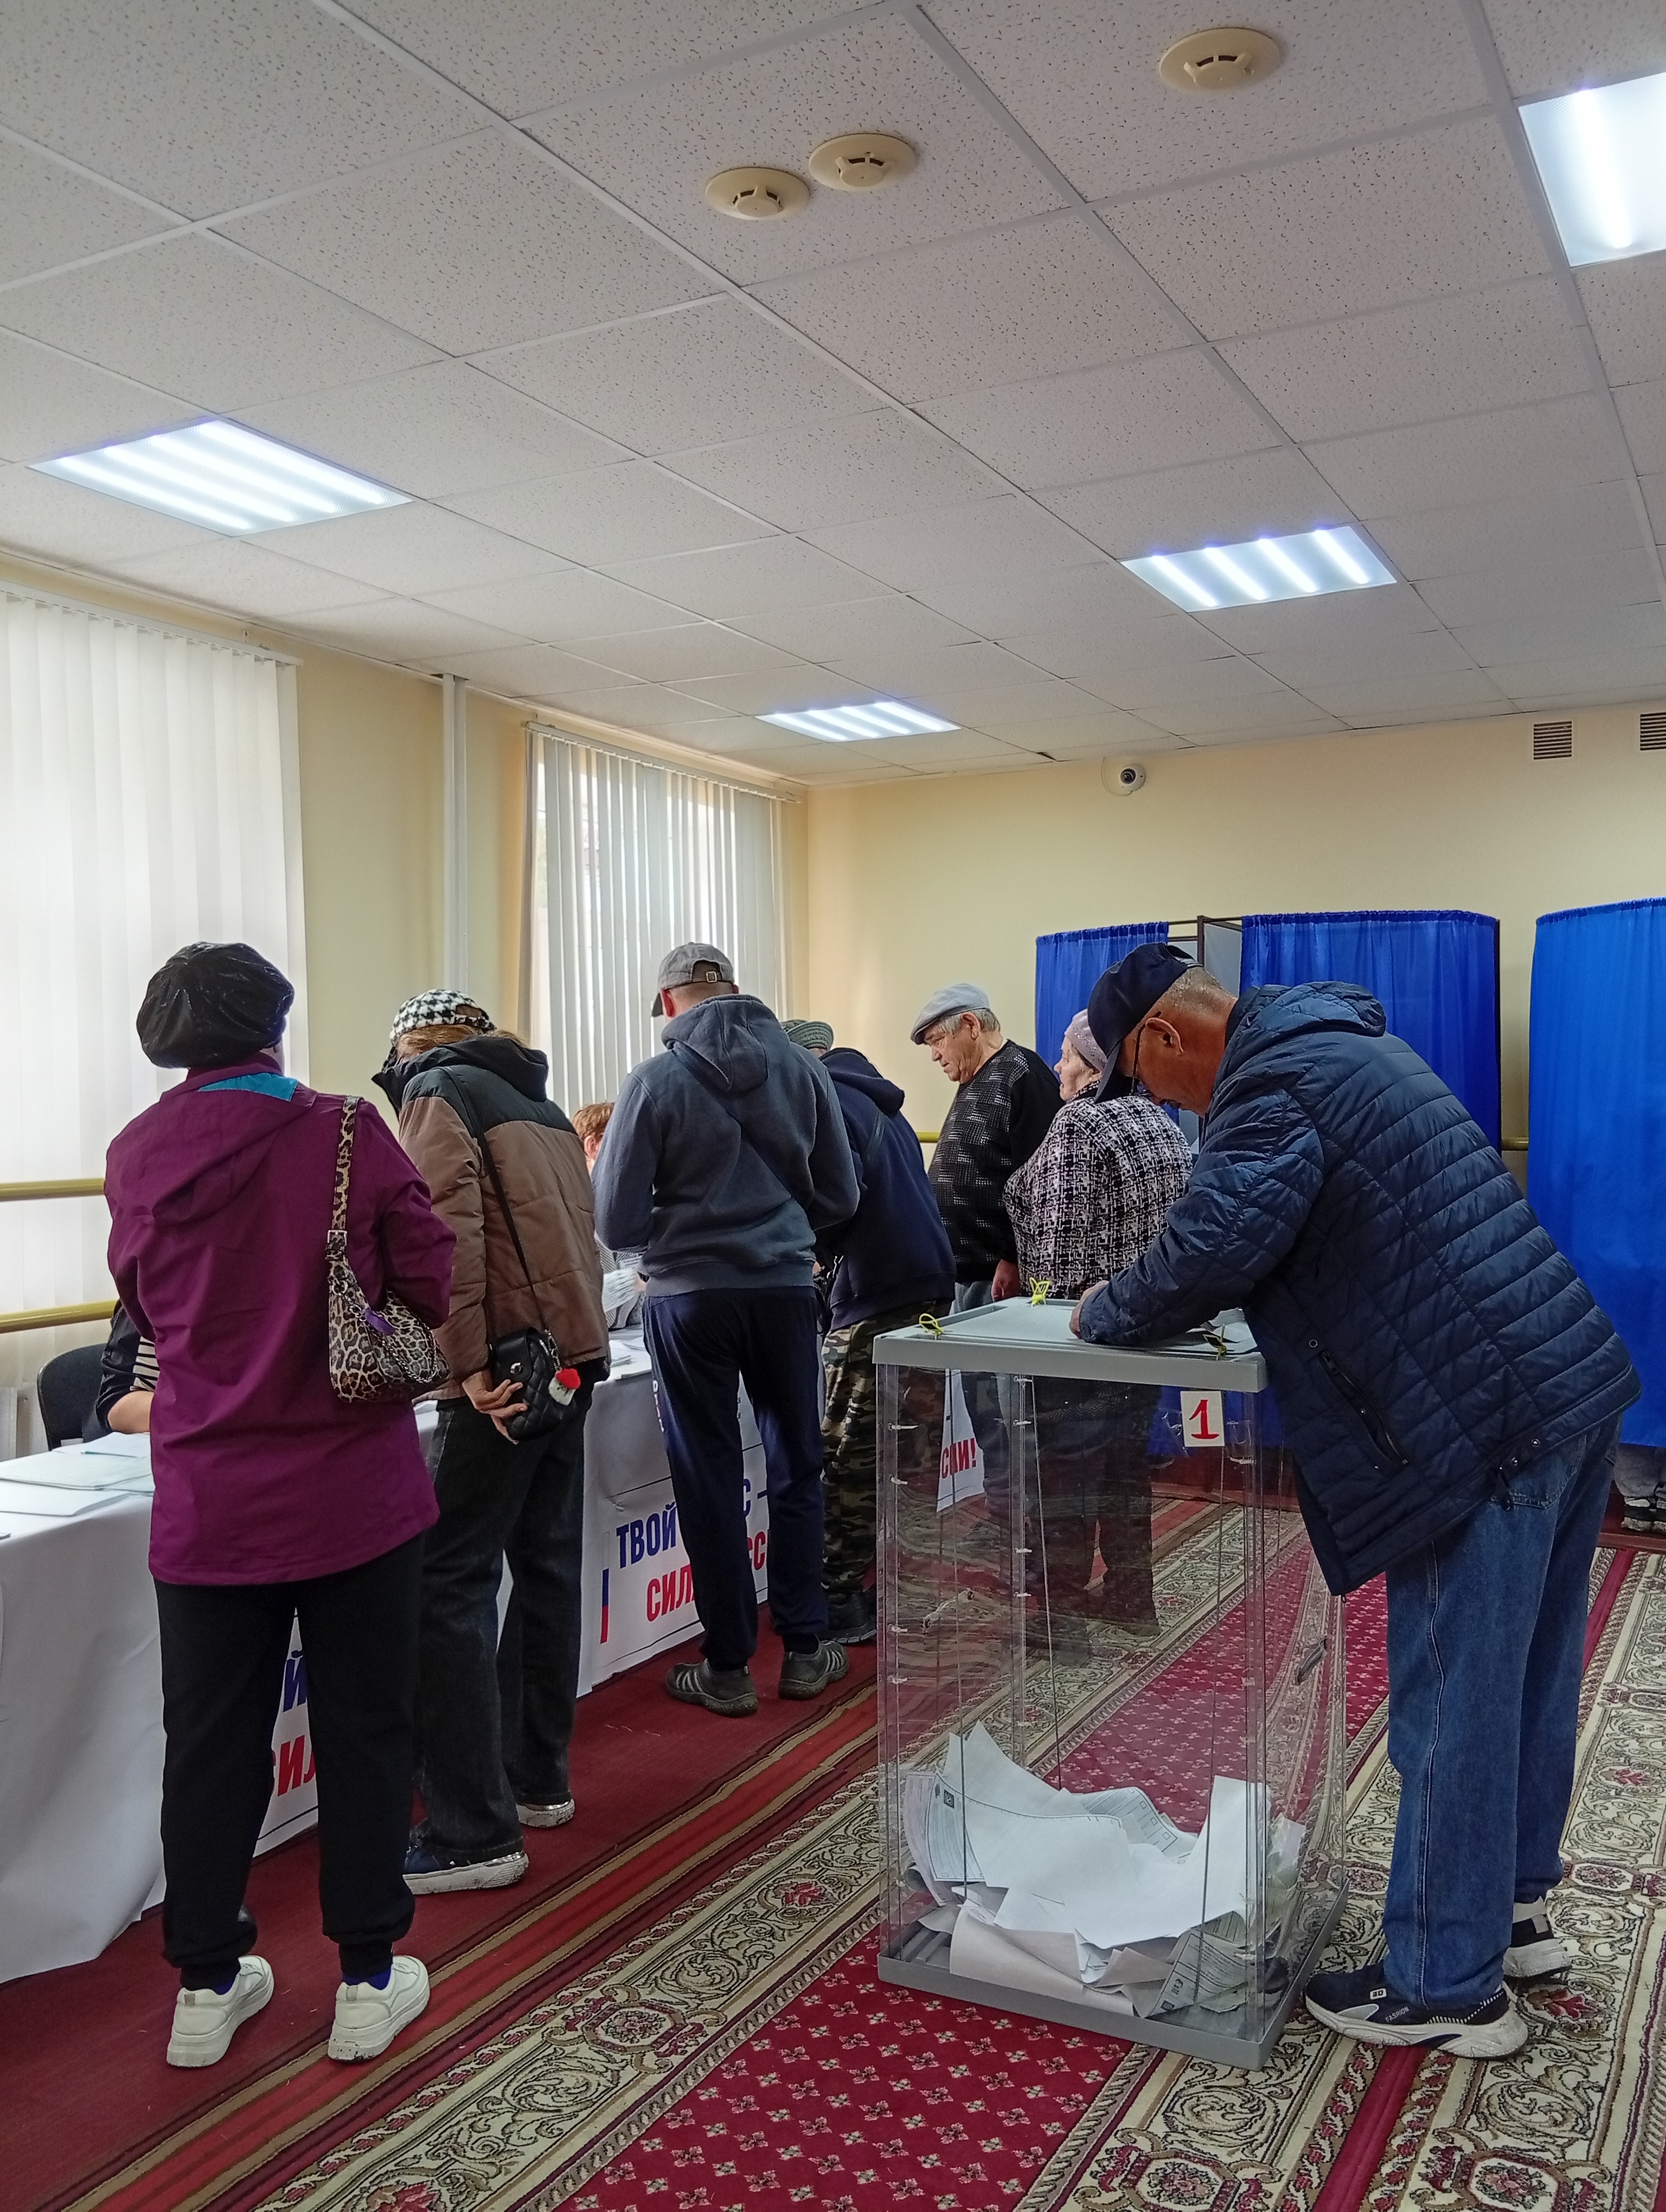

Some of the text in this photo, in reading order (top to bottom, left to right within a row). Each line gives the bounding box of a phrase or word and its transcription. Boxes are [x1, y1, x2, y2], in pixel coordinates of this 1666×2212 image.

[1189, 1399, 1220, 1439] 1
[616, 1501, 677, 1569] ТВОЙ
[646, 1564, 695, 1622] СИЛ
[1385, 2005, 1409, 2023] FASHION
